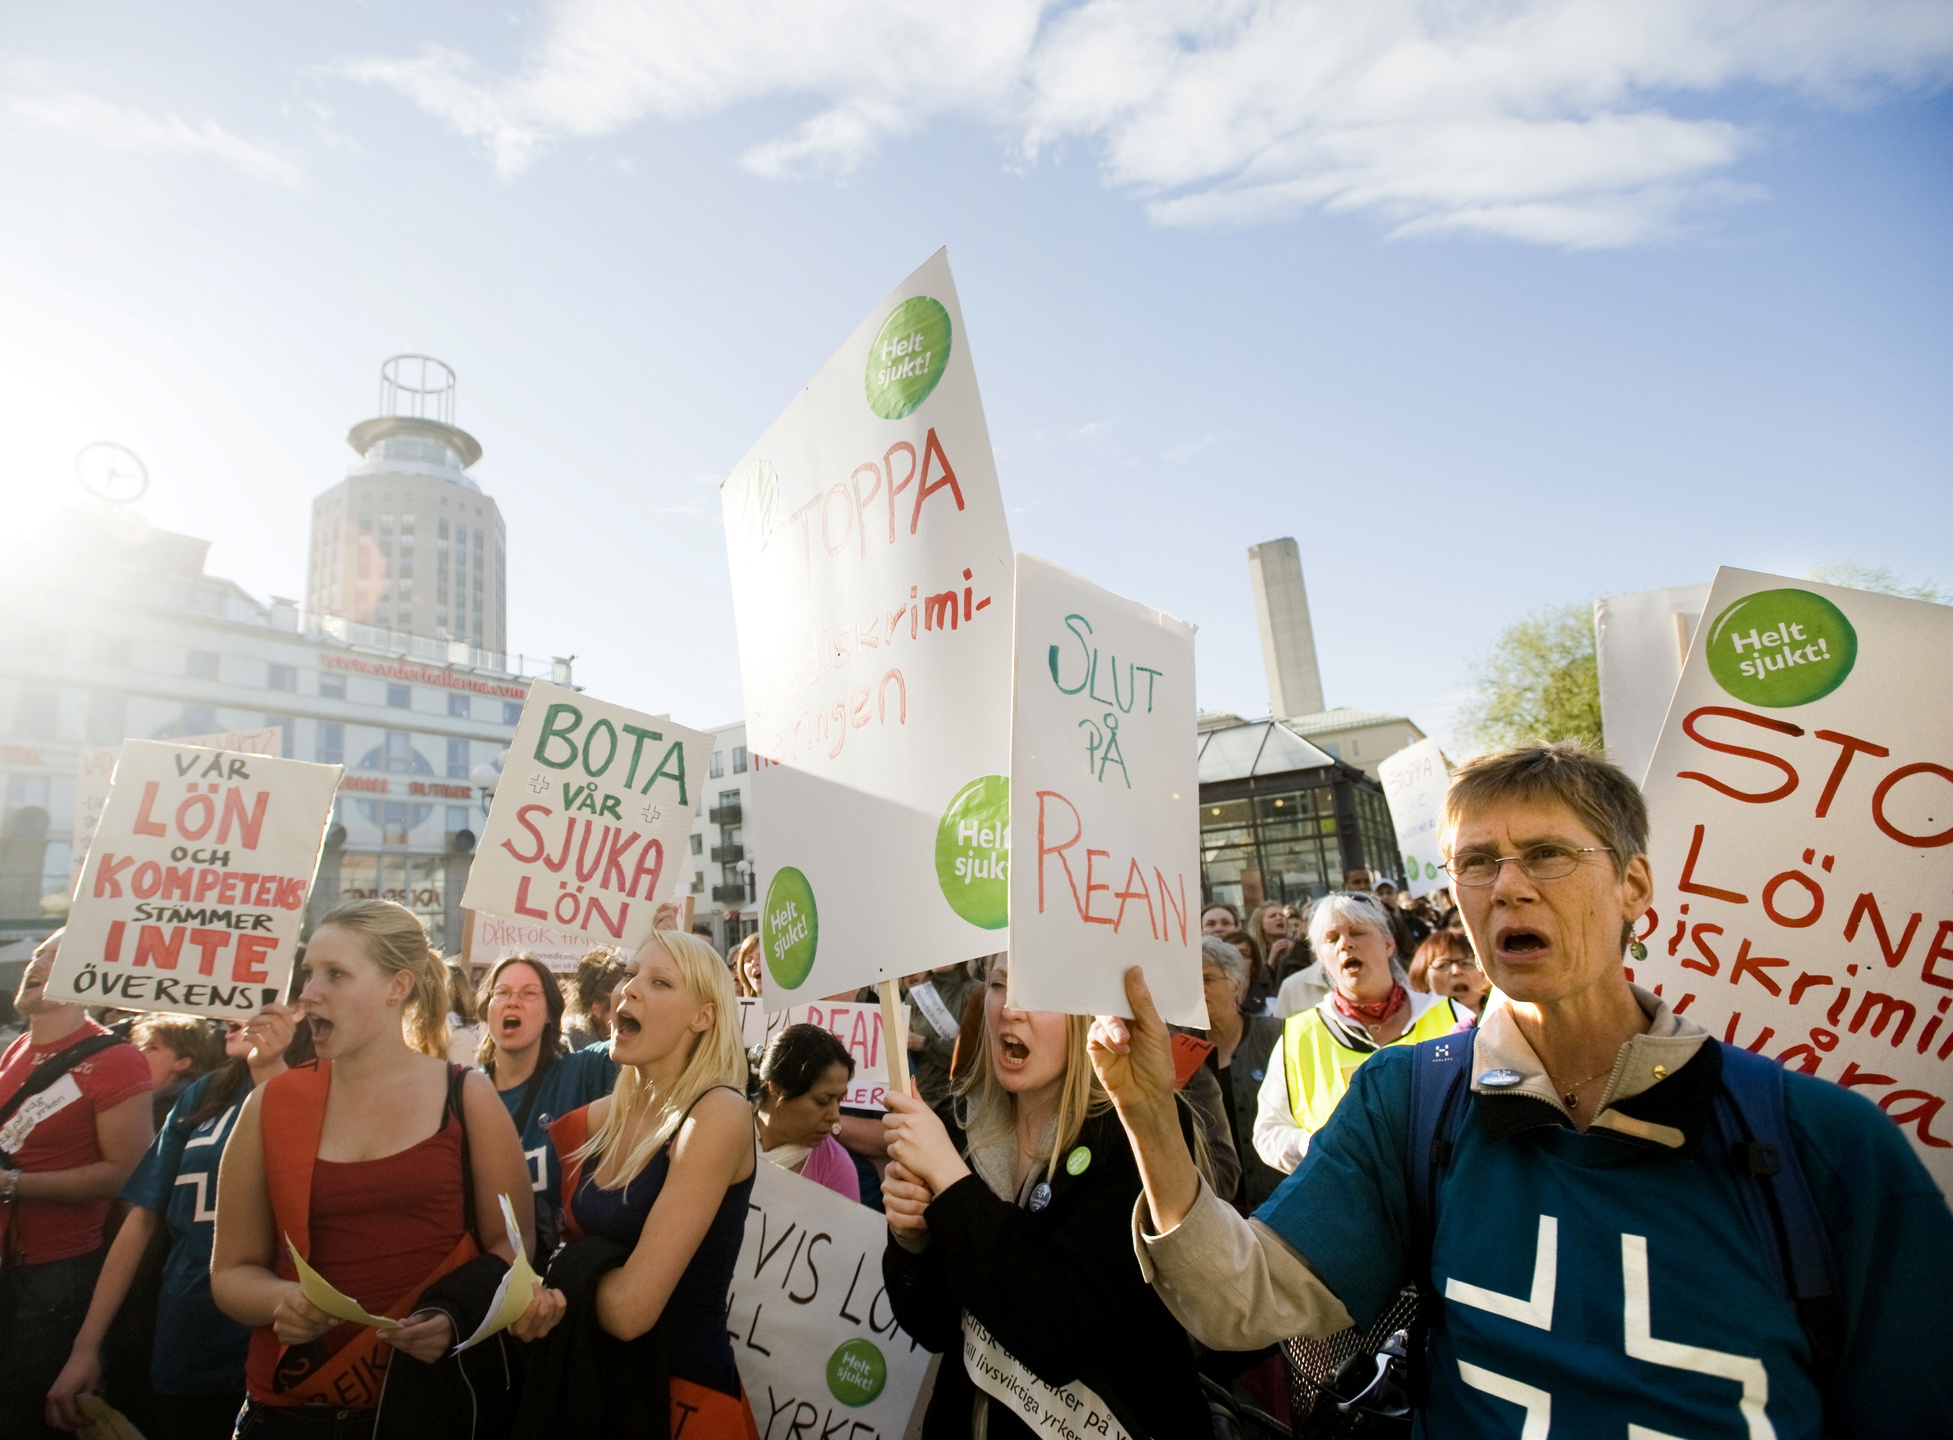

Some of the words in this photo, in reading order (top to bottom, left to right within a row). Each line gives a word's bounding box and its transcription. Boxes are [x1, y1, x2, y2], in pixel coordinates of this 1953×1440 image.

[881, 331, 924, 361] Helt
[878, 352, 930, 388] sjukt!
[1731, 622, 1807, 654] Helt
[1739, 638, 1831, 680] sjukt!
[1049, 613, 1162, 714] SLUT
[175, 753, 250, 780] VÅR
[533, 703, 690, 806] BOTA
[1078, 713, 1131, 789] PÅ
[133, 781, 270, 850] LÖN
[563, 782, 622, 821] VÅR
[171, 846, 230, 867] OCH
[500, 804, 664, 901] SJUKA
[1036, 790, 1188, 948] REAN
[93, 853, 306, 911] KOMPETENS
[132, 903, 273, 932] STÄMMER
[514, 876, 629, 939] LÖN
[770, 900, 798, 935] Helt
[104, 920, 279, 984] INTE
[774, 914, 808, 960] sjukt!
[836, 1366, 874, 1391] sjukt!
[842, 1352, 872, 1376] Helt
[965, 1341, 977, 1362] till
[976, 1353, 1041, 1415] livsviktiga
[1082, 1411, 1114, 1437] på
